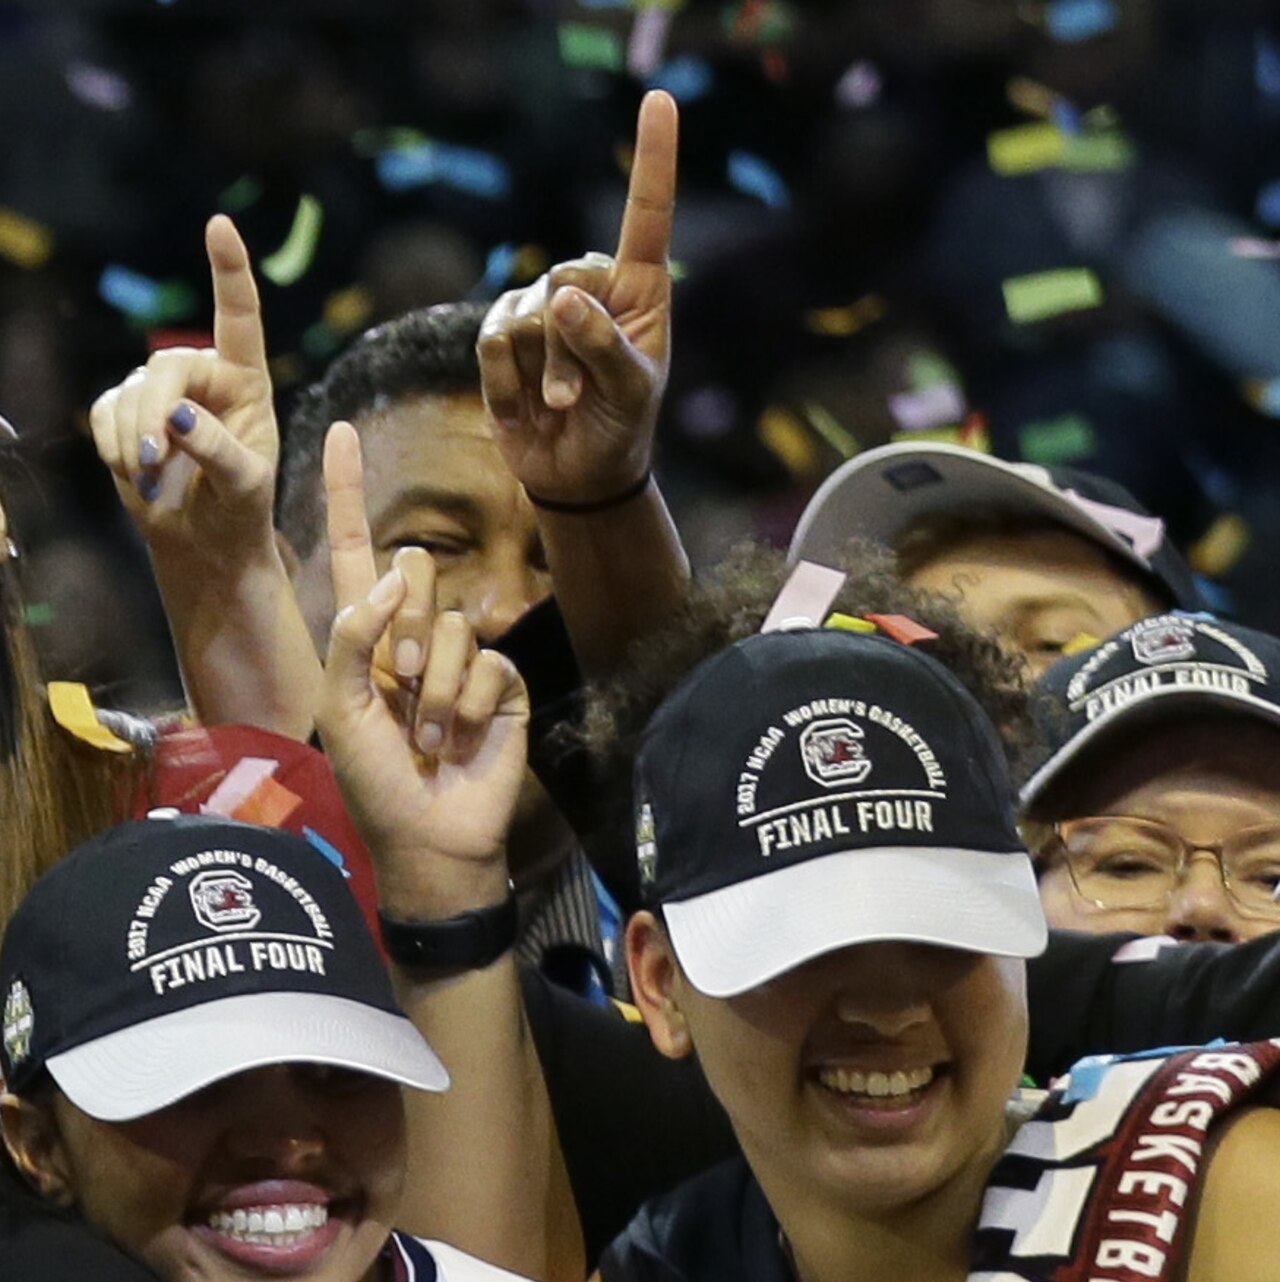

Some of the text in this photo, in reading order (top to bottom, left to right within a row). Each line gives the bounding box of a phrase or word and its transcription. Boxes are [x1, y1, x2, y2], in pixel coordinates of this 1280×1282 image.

[738, 698, 948, 814] 2017 NCAA WOMEN'S BASKETBALL
[757, 799, 933, 857] FINAL FOUR
[126, 850, 334, 961] 2017 NCAA WOMEN'S BASKETBALL
[149, 942, 326, 995] FINAL FOUR
